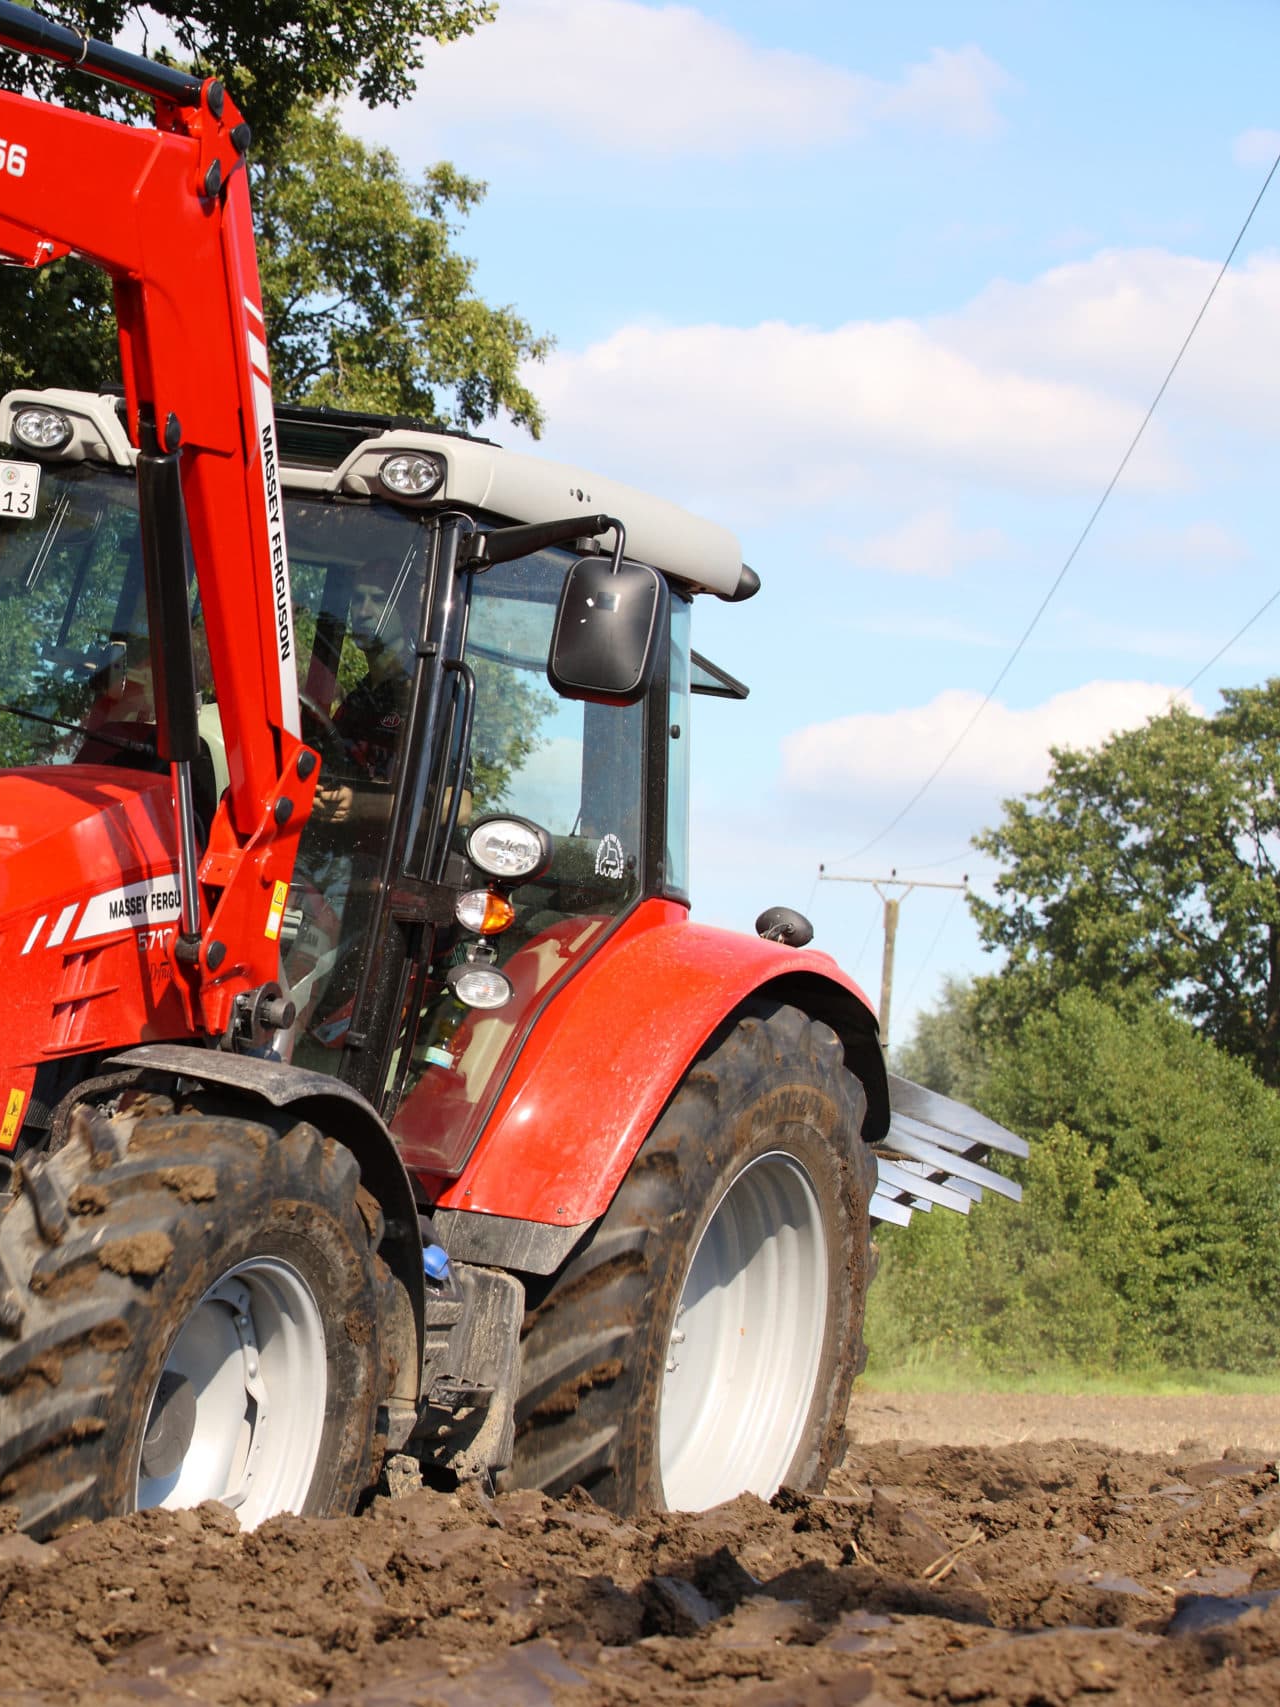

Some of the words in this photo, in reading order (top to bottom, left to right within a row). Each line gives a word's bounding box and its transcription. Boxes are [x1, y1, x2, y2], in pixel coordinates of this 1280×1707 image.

[262, 424, 279, 523] MASSEY
[271, 531, 290, 662] FERGUSON
[109, 894, 148, 920] MASSEY
[150, 890, 181, 911] FERGU
